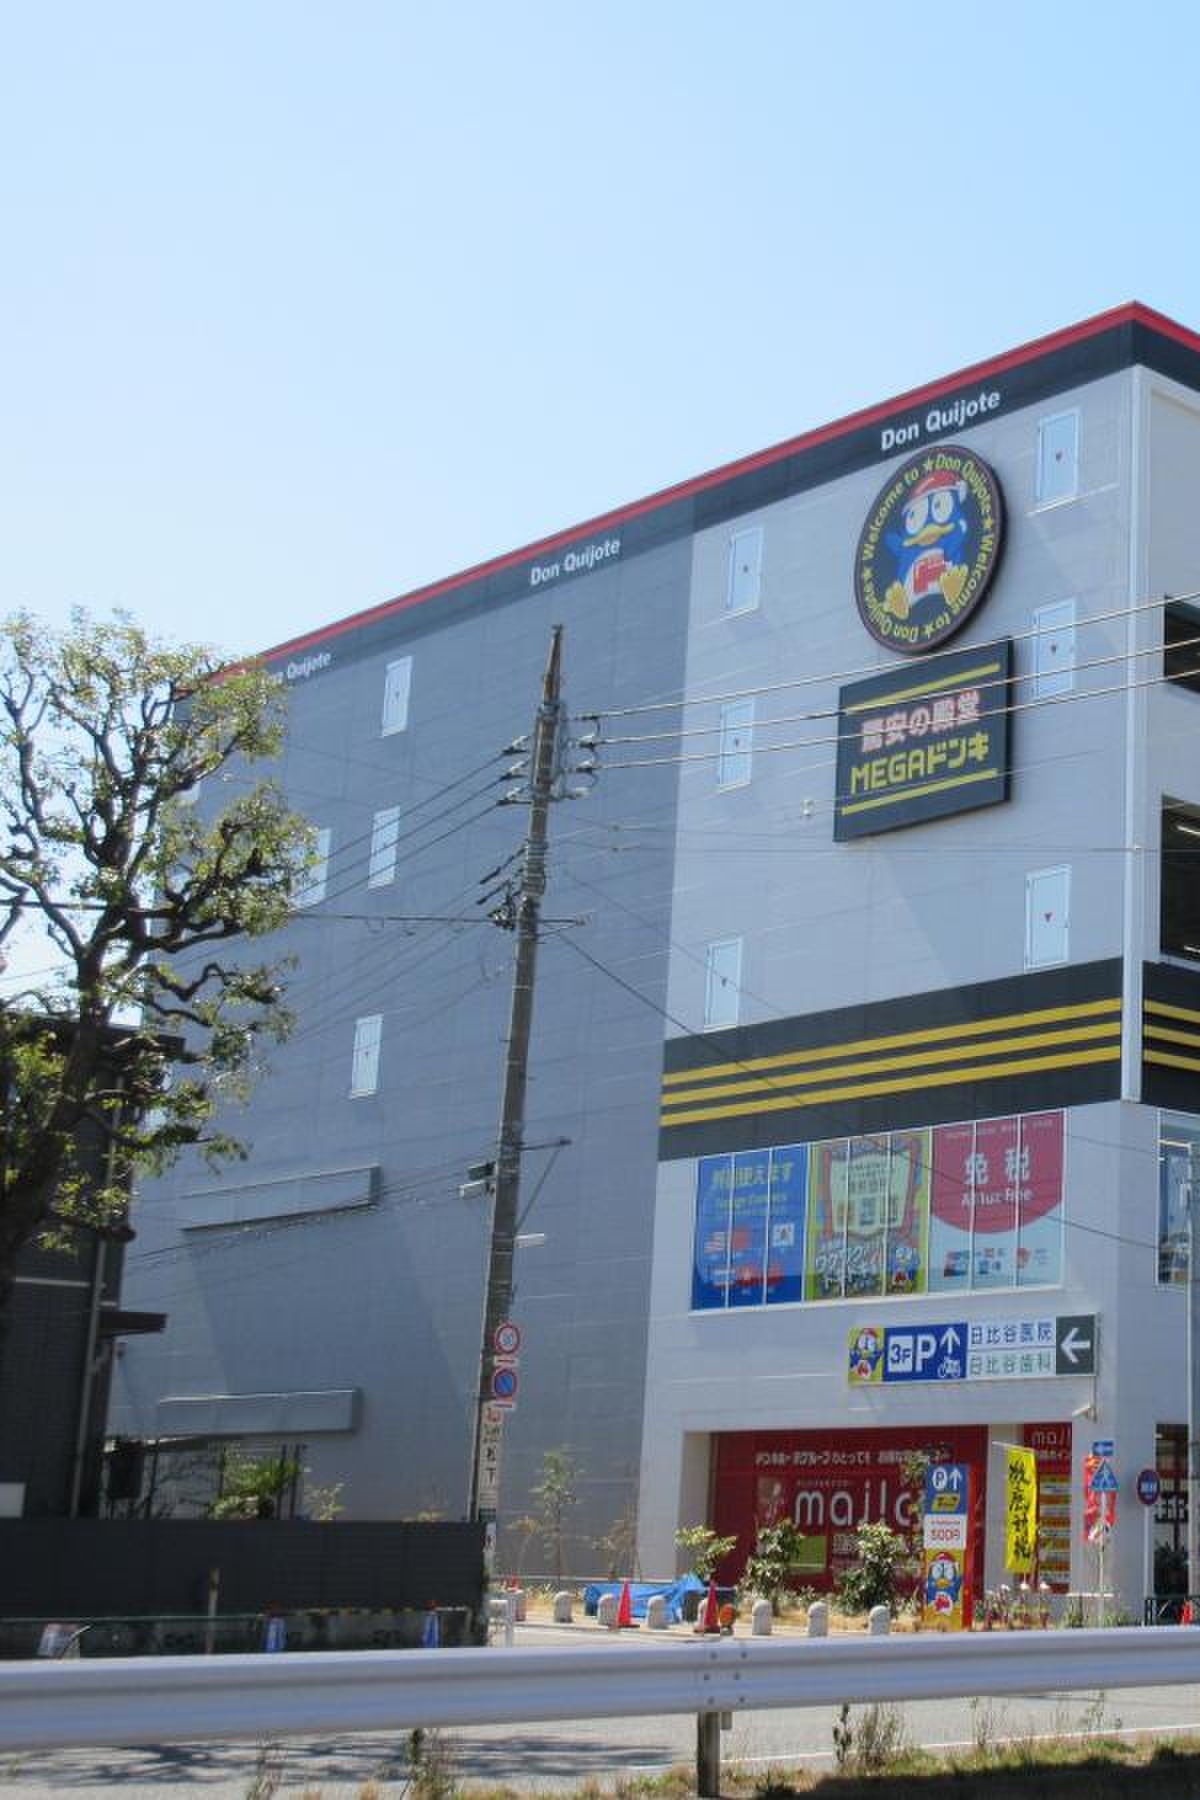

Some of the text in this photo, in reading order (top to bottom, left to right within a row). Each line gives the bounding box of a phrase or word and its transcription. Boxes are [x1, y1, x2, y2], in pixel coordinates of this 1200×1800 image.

[881, 390, 1000, 450] Don Quijote
[862, 484, 904, 561] Welcome
[530, 540, 621, 586] Don Quijote
[850, 732, 989, 795] MEGAドンキ
[915, 1335, 936, 1372] P
[970, 1322, 1053, 1346] 日比谷医院
